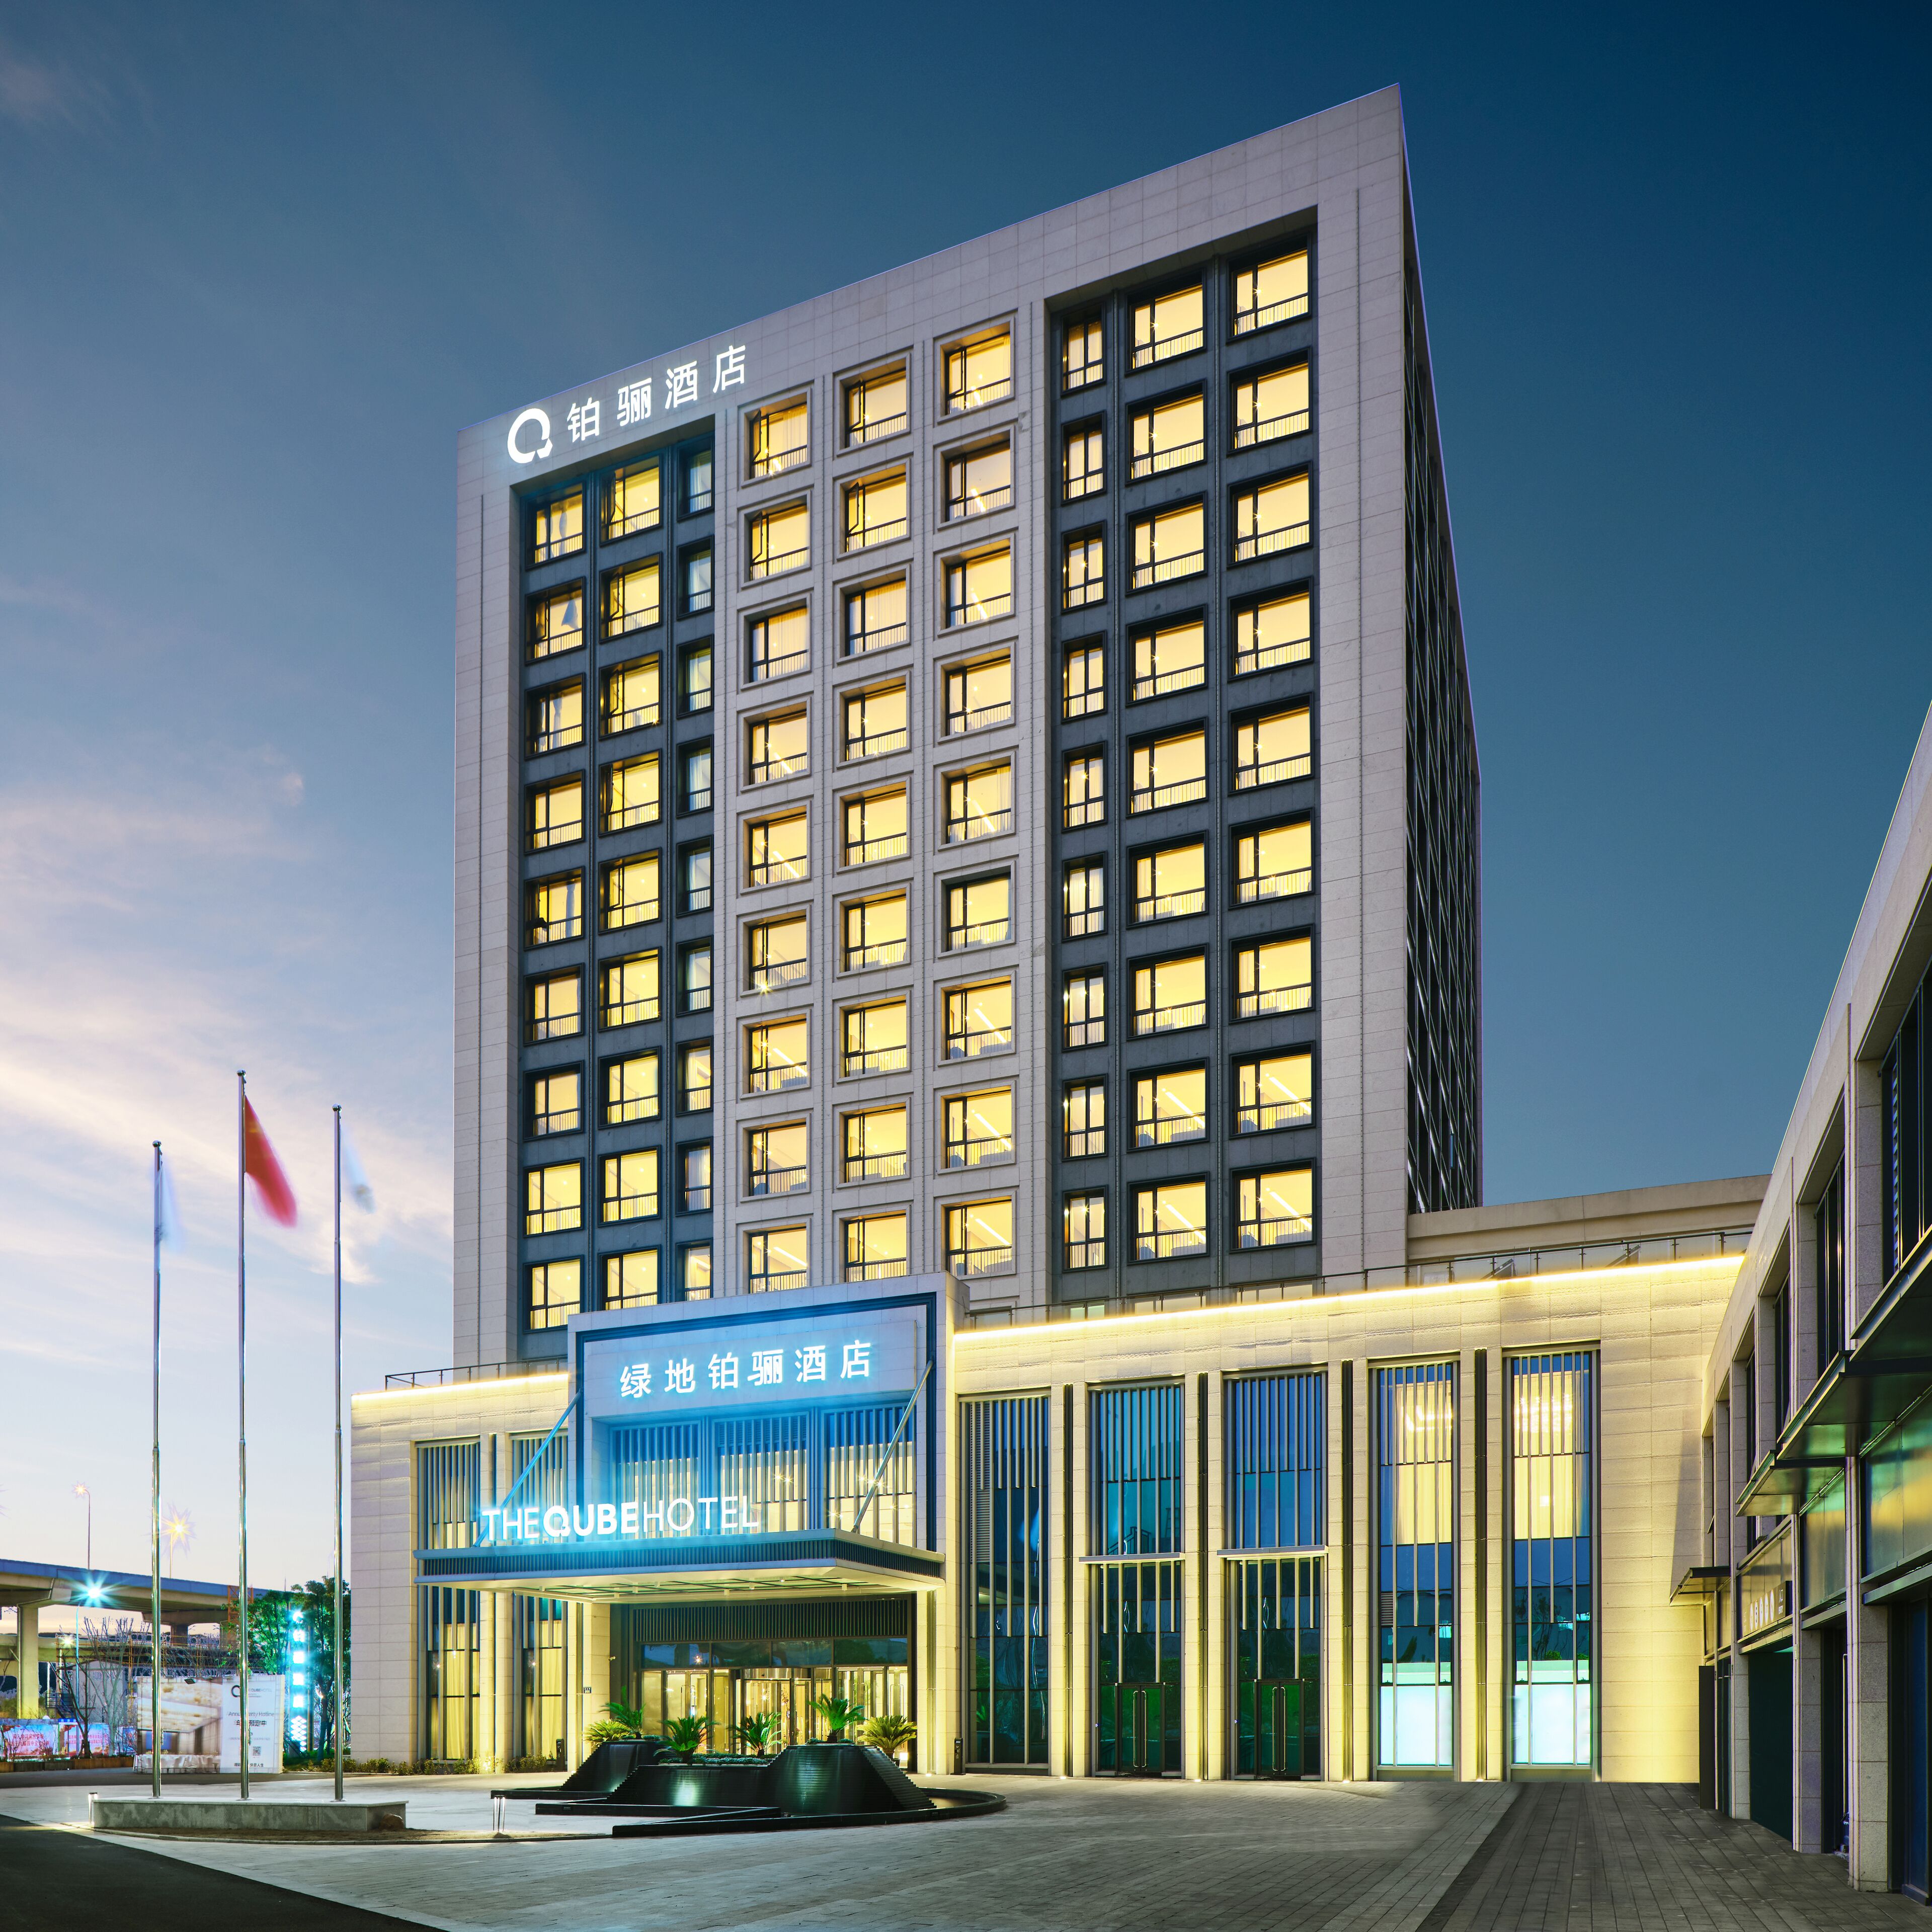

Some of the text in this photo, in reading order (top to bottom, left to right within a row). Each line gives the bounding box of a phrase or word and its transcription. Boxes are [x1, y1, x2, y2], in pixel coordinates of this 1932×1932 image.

[567, 345, 746, 443] 铂骊酒店
[619, 1340, 871, 1399] 绿地铂骊酒店
